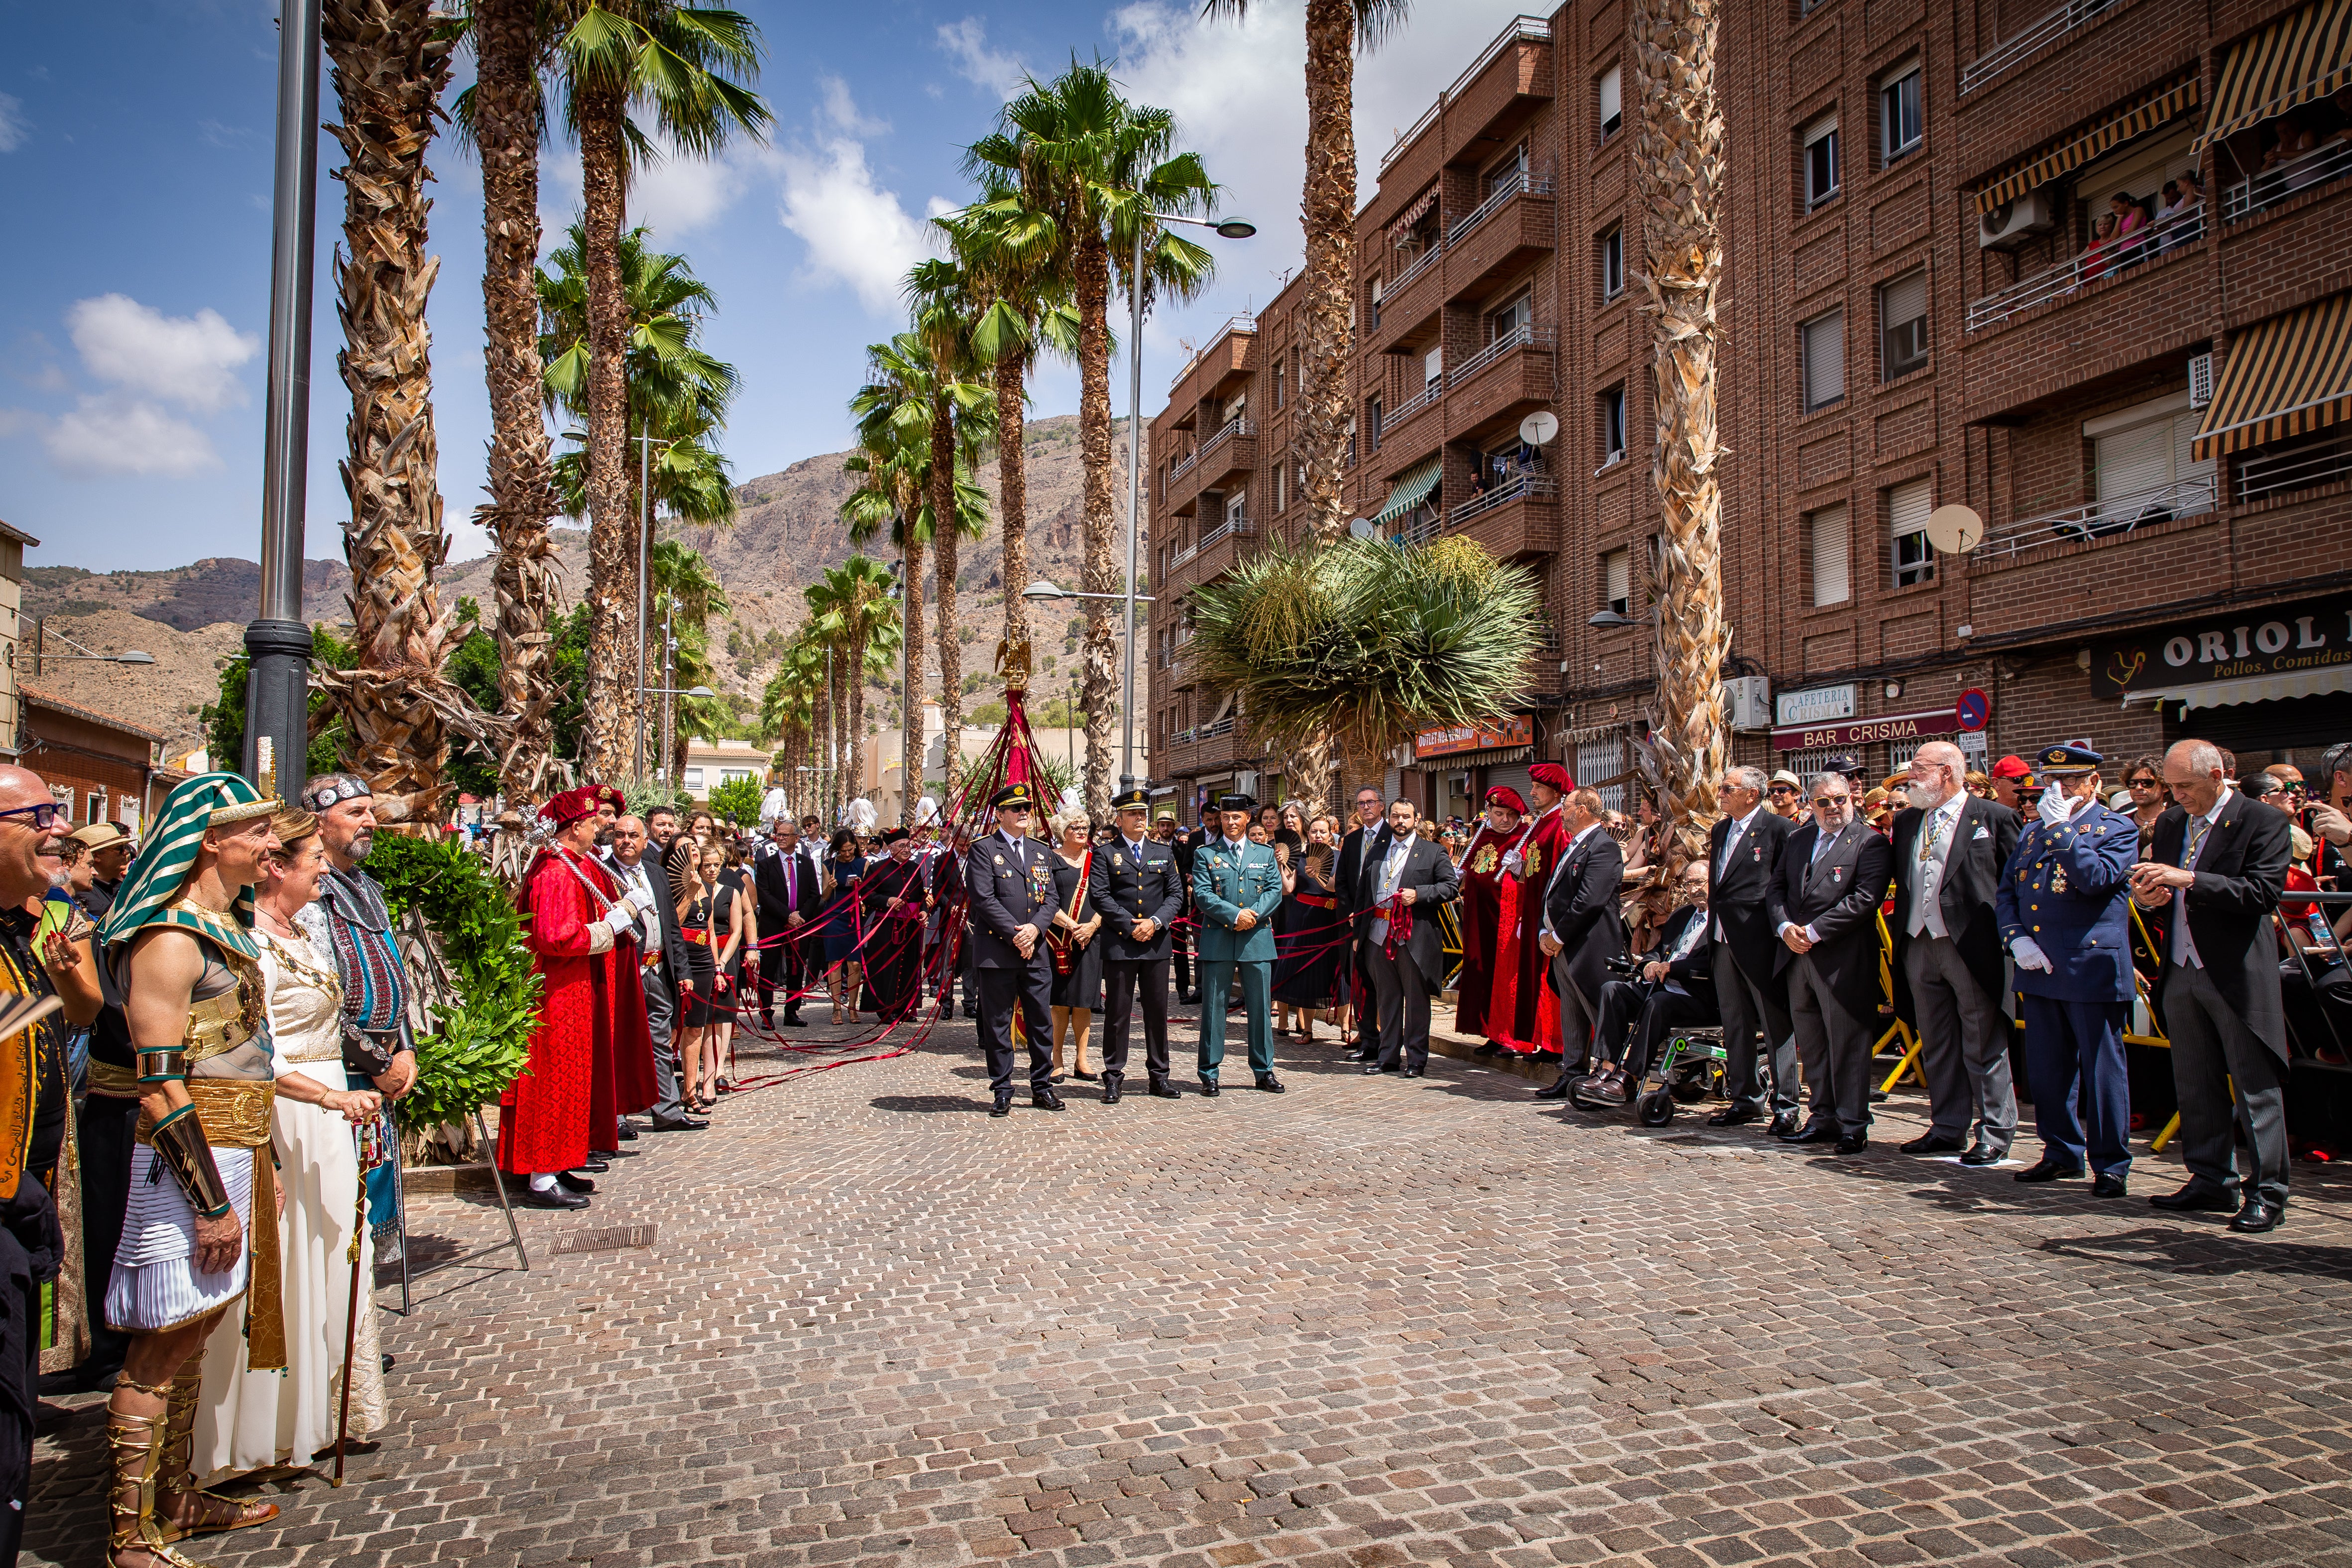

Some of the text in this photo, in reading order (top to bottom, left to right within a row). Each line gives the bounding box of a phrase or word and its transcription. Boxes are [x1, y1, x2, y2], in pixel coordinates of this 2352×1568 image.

[2164, 616, 2326, 666] ORIOL
[2214, 649, 2351, 678] Pollos, Comidas
[1780, 689, 1849, 723] CAFETERIA
[1788, 703, 1841, 721] CRISMA
[1418, 731, 1437, 747] OUTLET
[1804, 721, 1917, 746] BAR CRISMA
